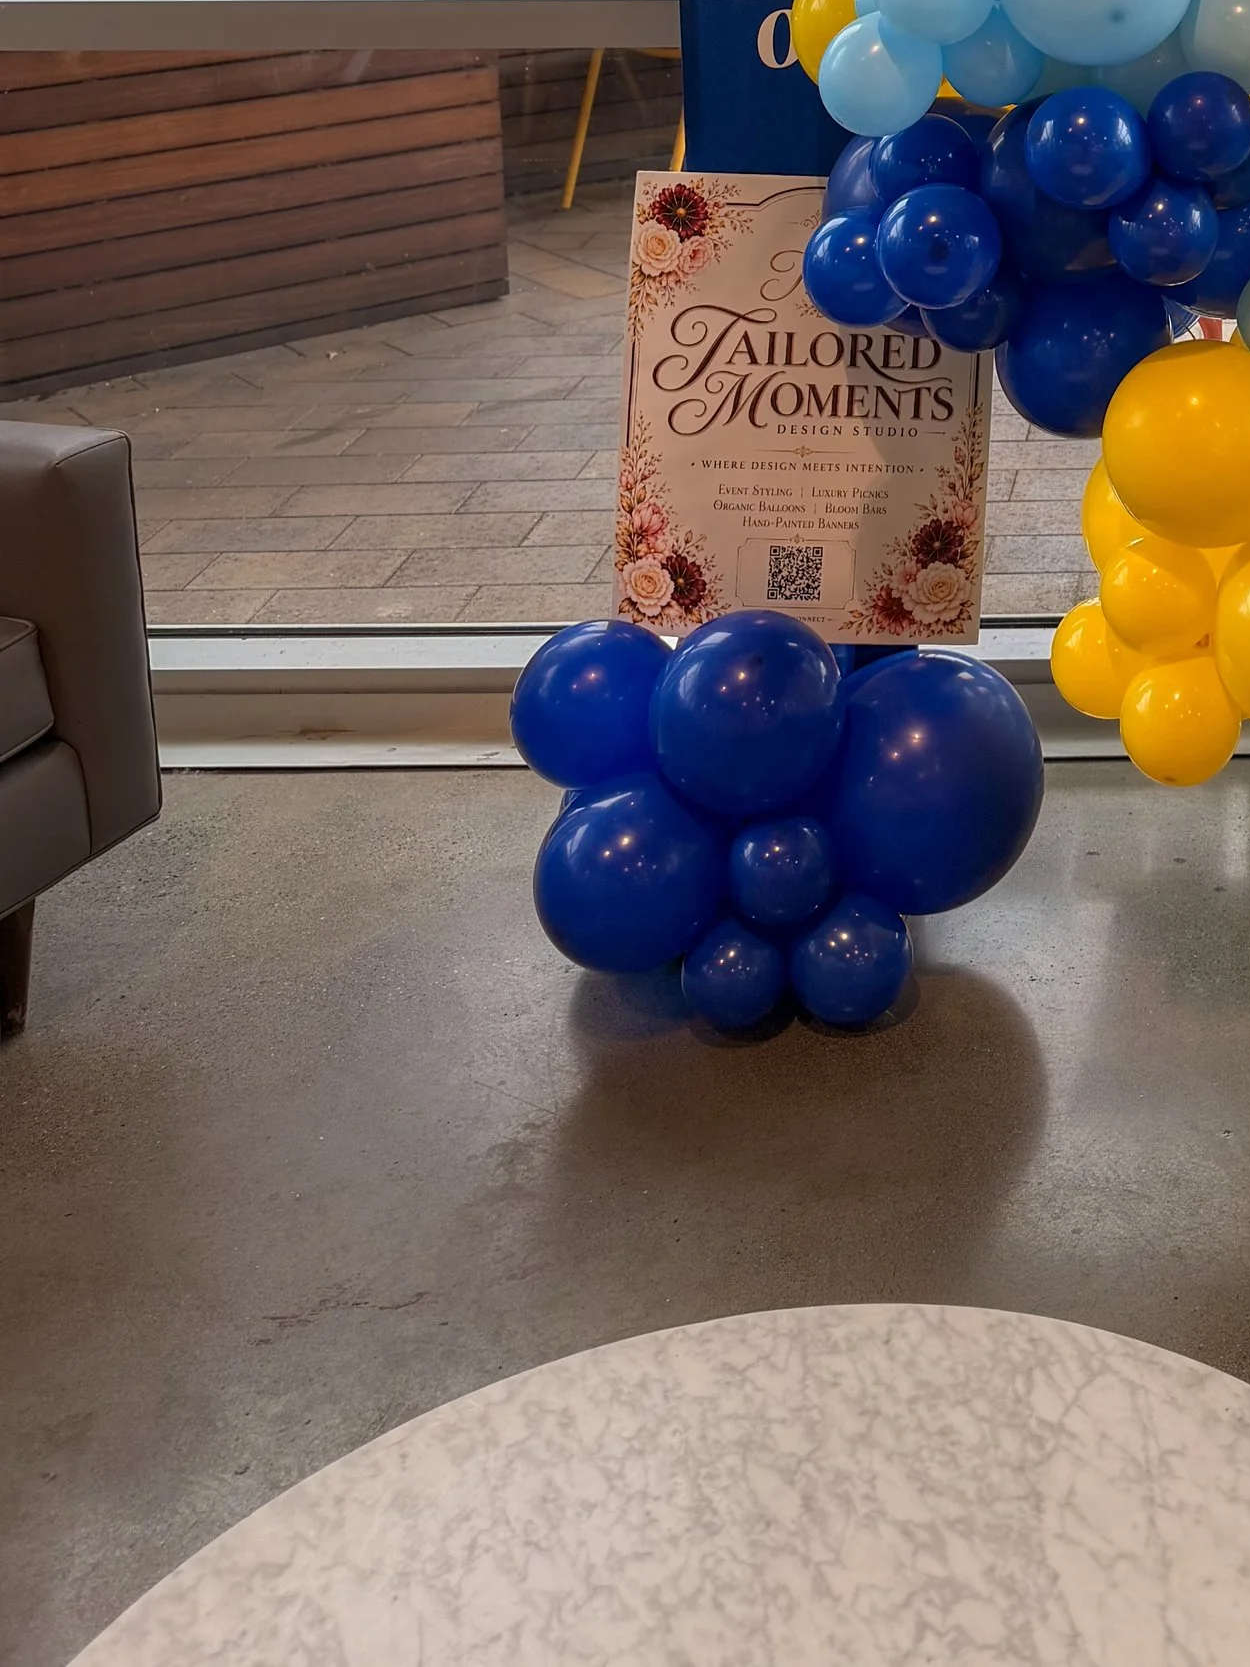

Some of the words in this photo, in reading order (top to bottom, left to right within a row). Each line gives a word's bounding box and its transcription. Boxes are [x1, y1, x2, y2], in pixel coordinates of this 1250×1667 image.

[652, 304, 952, 391] TAILORED
[667, 370, 954, 436] MOMENTS
[777, 424, 843, 435] DESIGN
[852, 426, 918, 438] STUDIO
[701, 460, 746, 470] WHERE
[751, 461, 797, 471] DESIGN
[802, 462, 840, 472] MEETS
[846, 463, 914, 474] INTENTION
